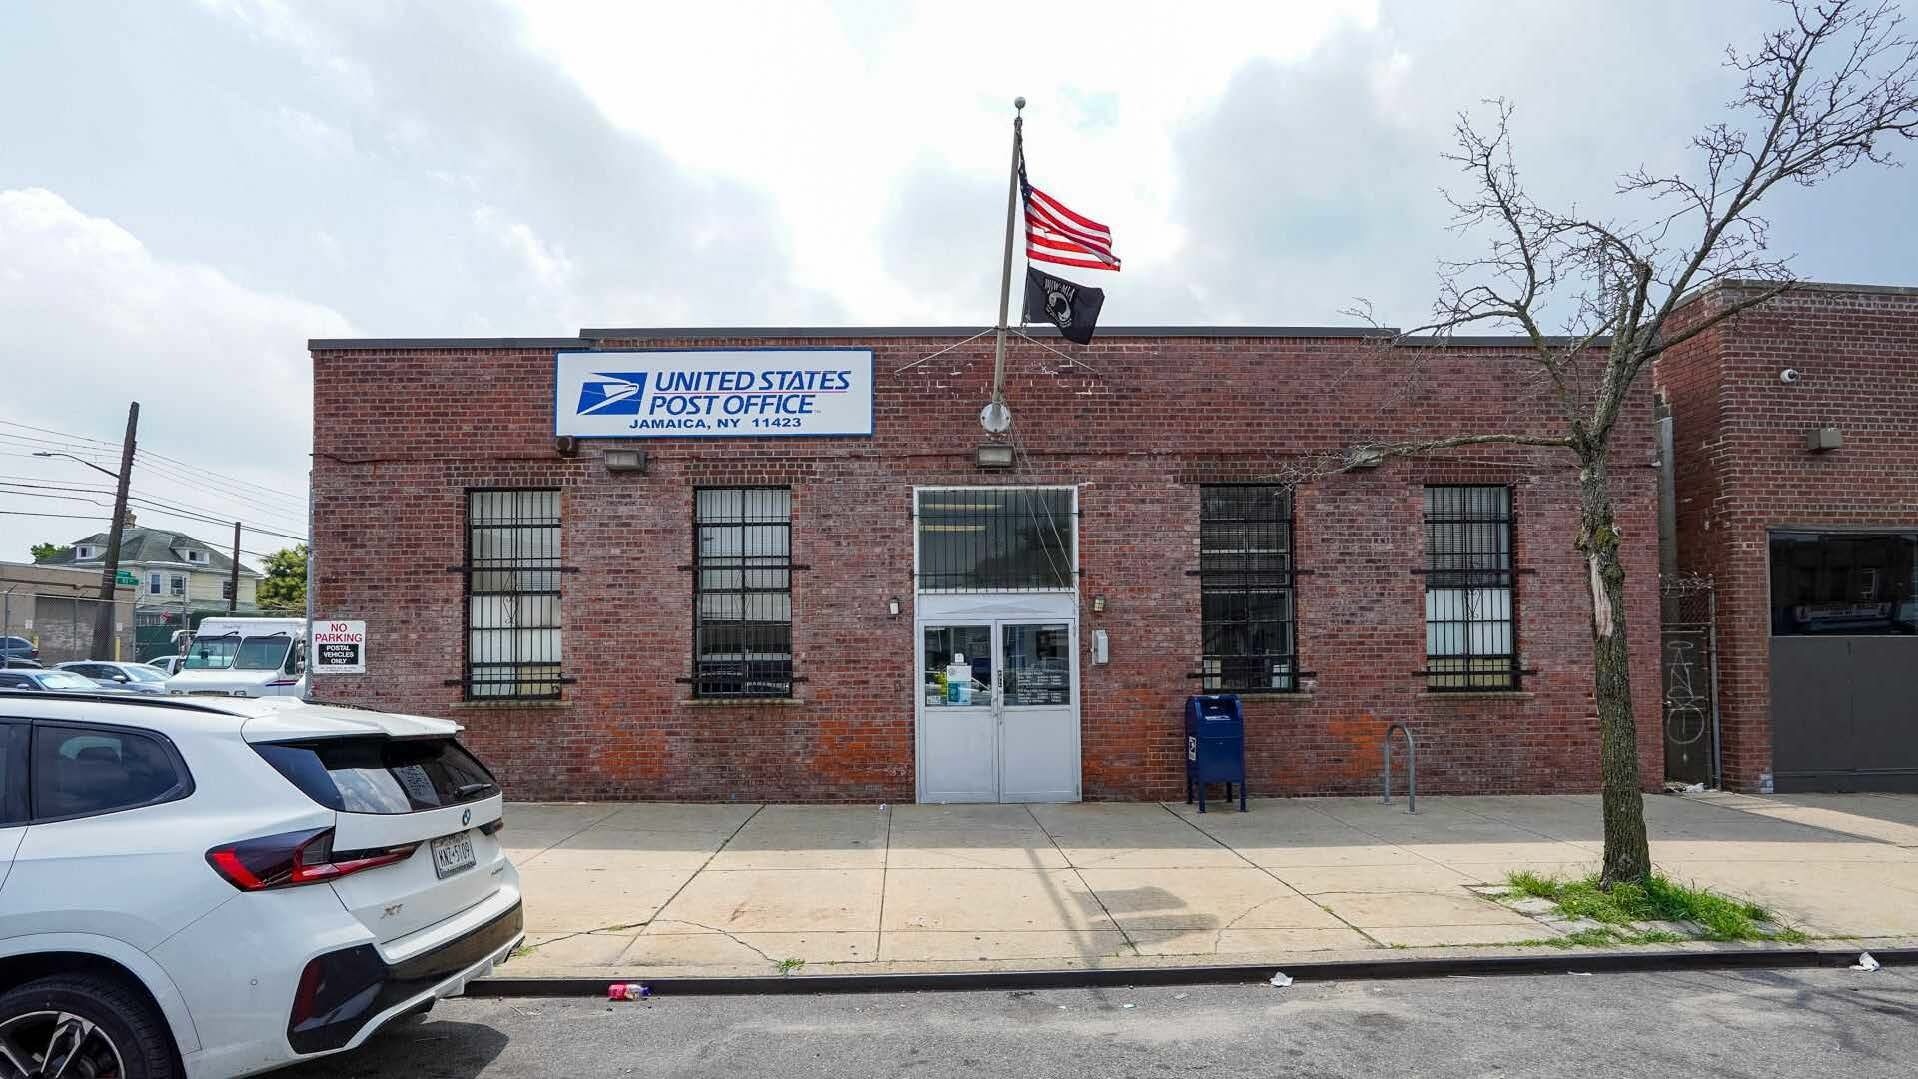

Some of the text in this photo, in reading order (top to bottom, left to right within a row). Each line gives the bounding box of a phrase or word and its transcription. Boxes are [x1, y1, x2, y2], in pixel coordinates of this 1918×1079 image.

[655, 370, 851, 391] UNITED STATES
[649, 394, 816, 415] POST OFFICE
[629, 418, 802, 430] JAMAICA, NY 11423
[331, 623, 347, 632] NO
[315, 633, 362, 642] PARKING
